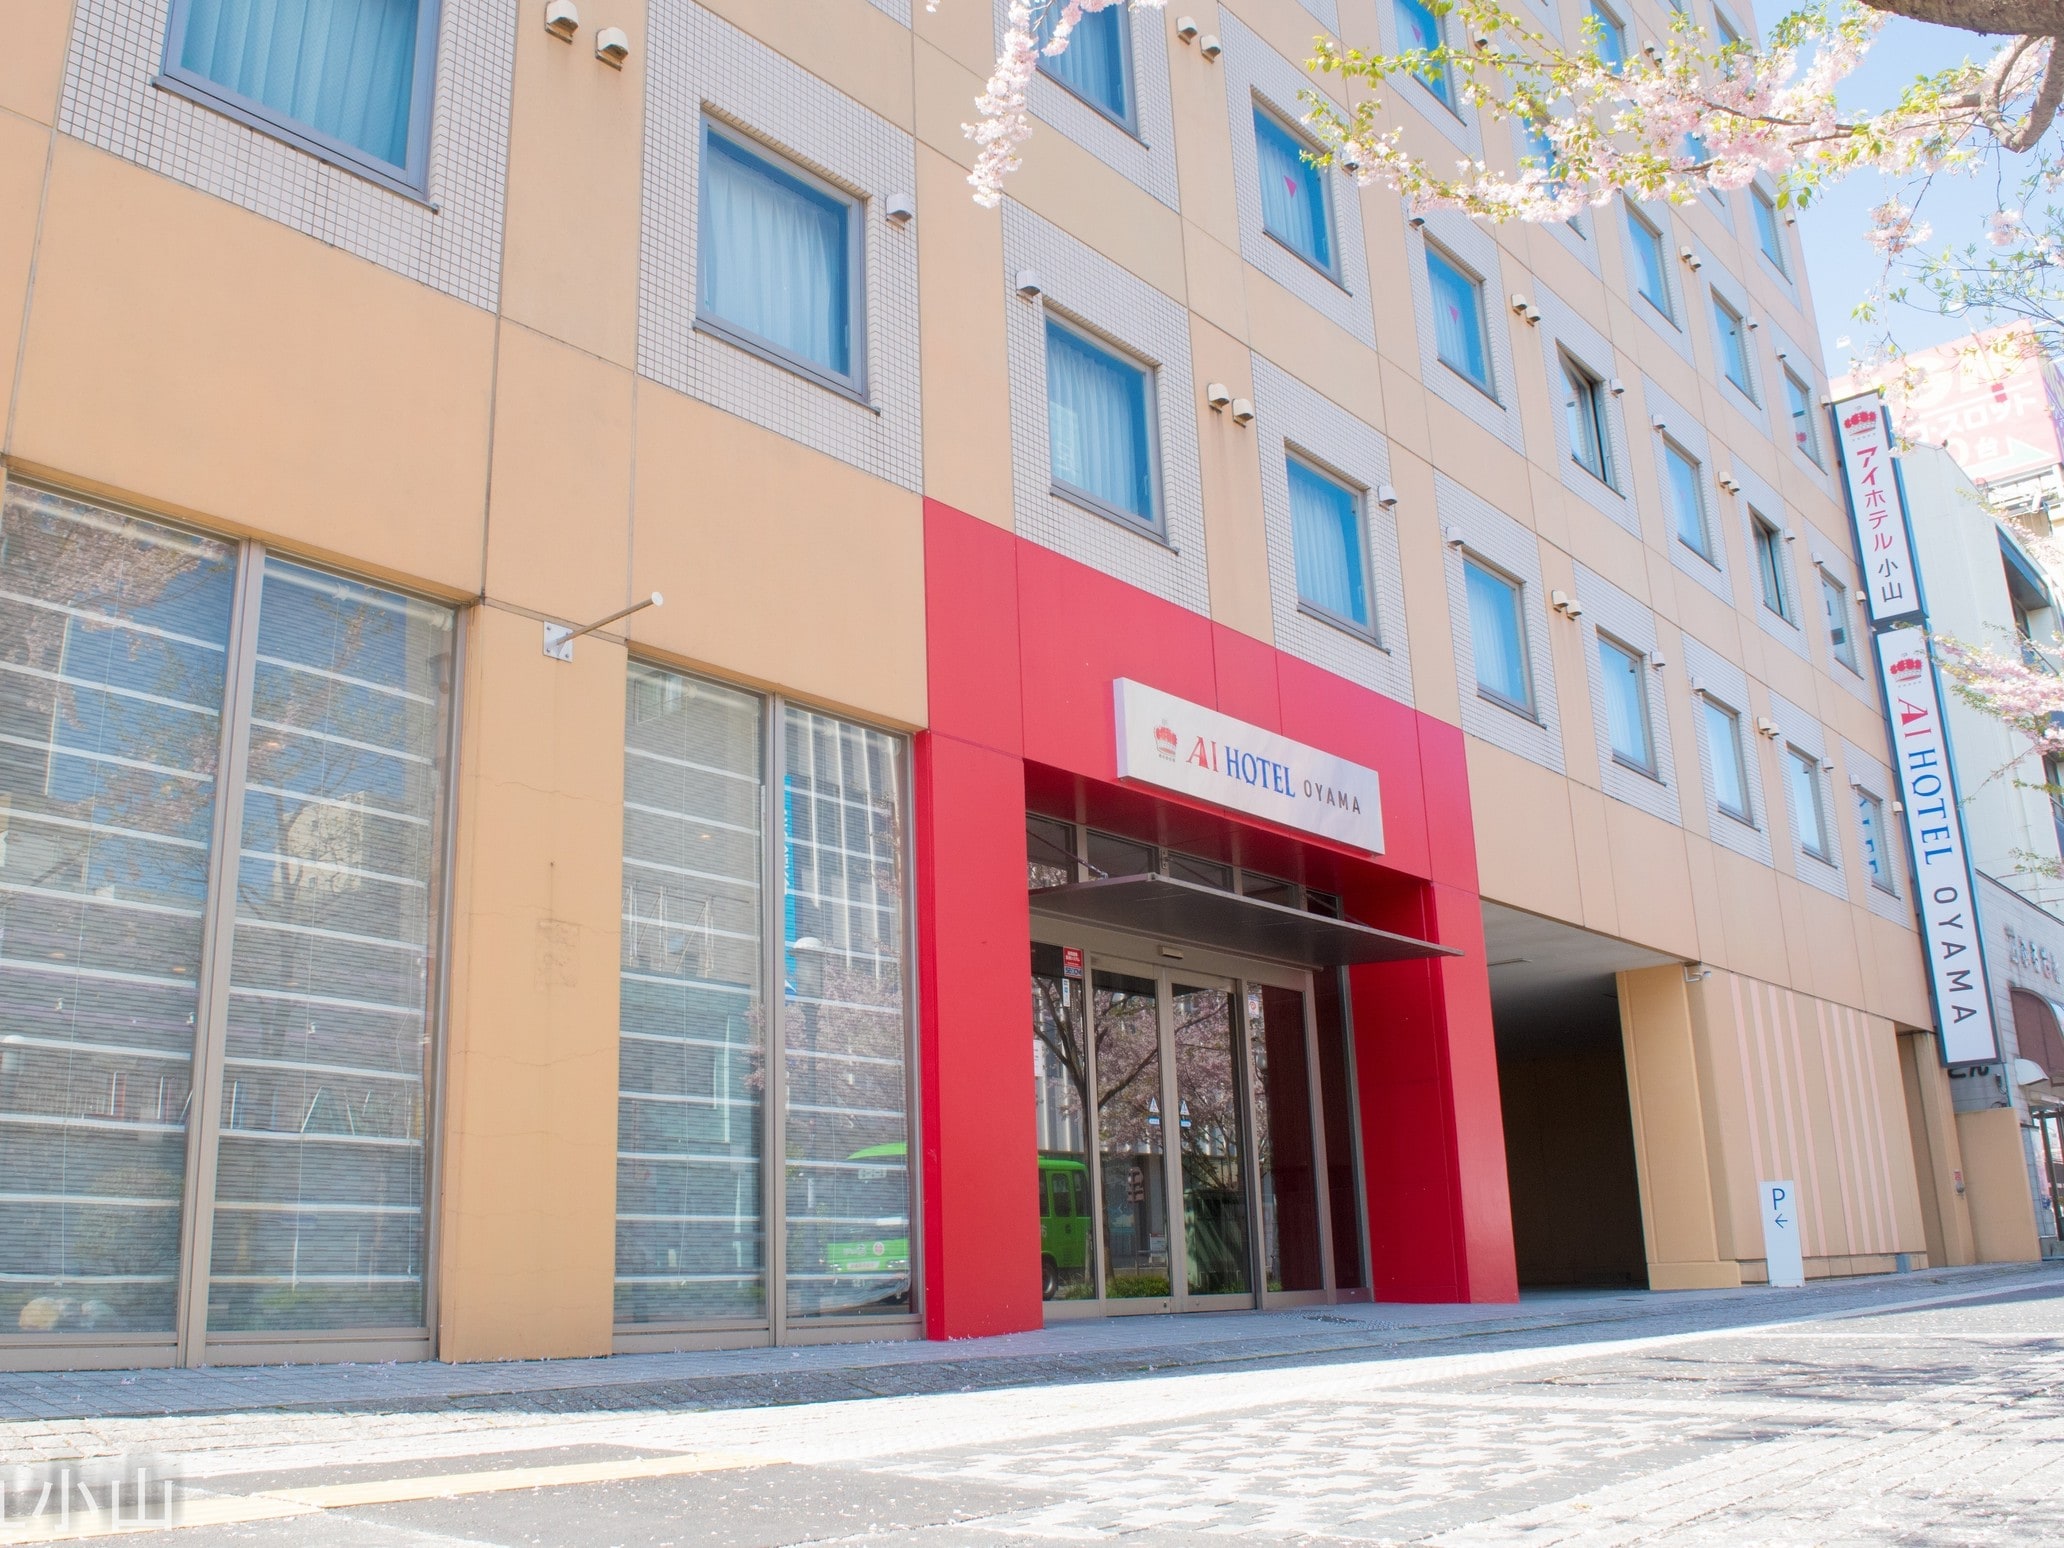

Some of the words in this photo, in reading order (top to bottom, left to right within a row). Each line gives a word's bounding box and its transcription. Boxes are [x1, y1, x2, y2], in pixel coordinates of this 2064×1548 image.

[1898, 696, 1932, 738] AI
[1186, 735, 1219, 773] AI
[1225, 746, 1296, 798] HOTEL
[1303, 779, 1361, 815] OYAMA
[1908, 748, 1953, 865] HOTEL
[1933, 886, 1977, 1024] OYAMA
[1772, 1187, 1786, 1211] P
